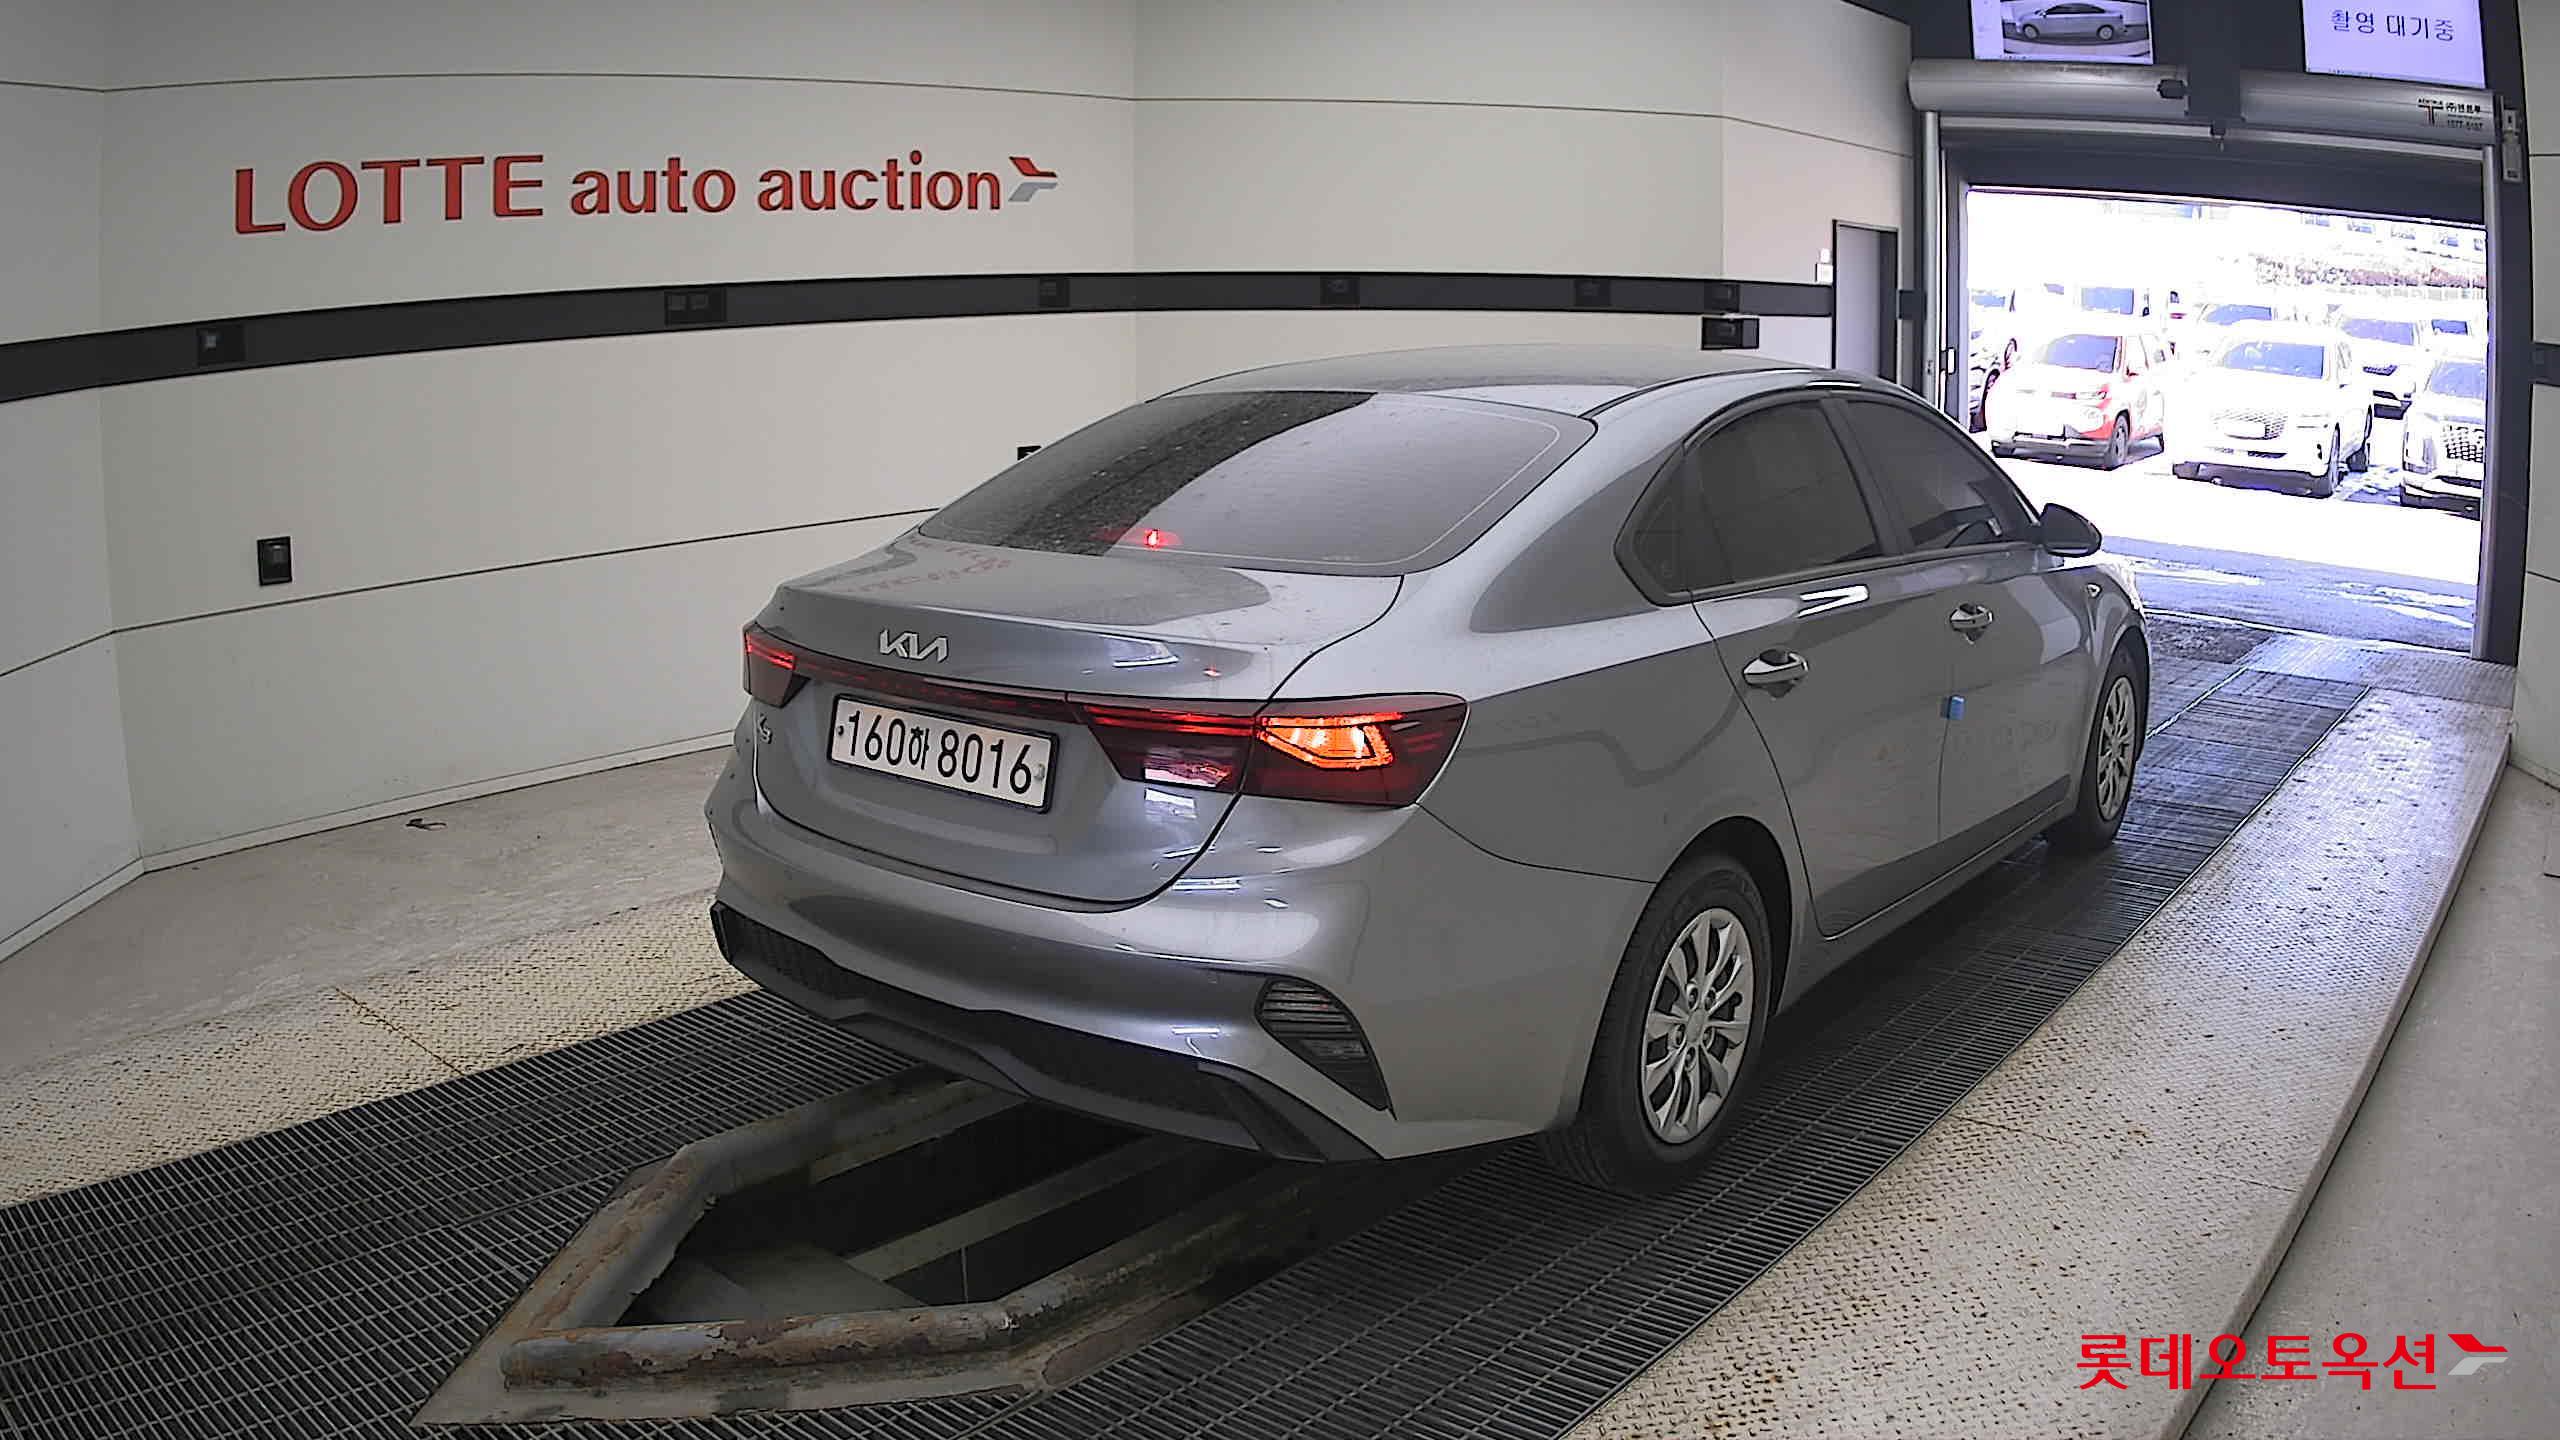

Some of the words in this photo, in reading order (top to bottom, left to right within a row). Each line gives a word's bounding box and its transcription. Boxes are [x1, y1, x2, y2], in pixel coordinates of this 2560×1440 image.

[2386, 15, 2455, 42] 대기중
[235, 154, 544, 234] LOTTE
[571, 158, 737, 215] auto
[757, 151, 1002, 210] auction
